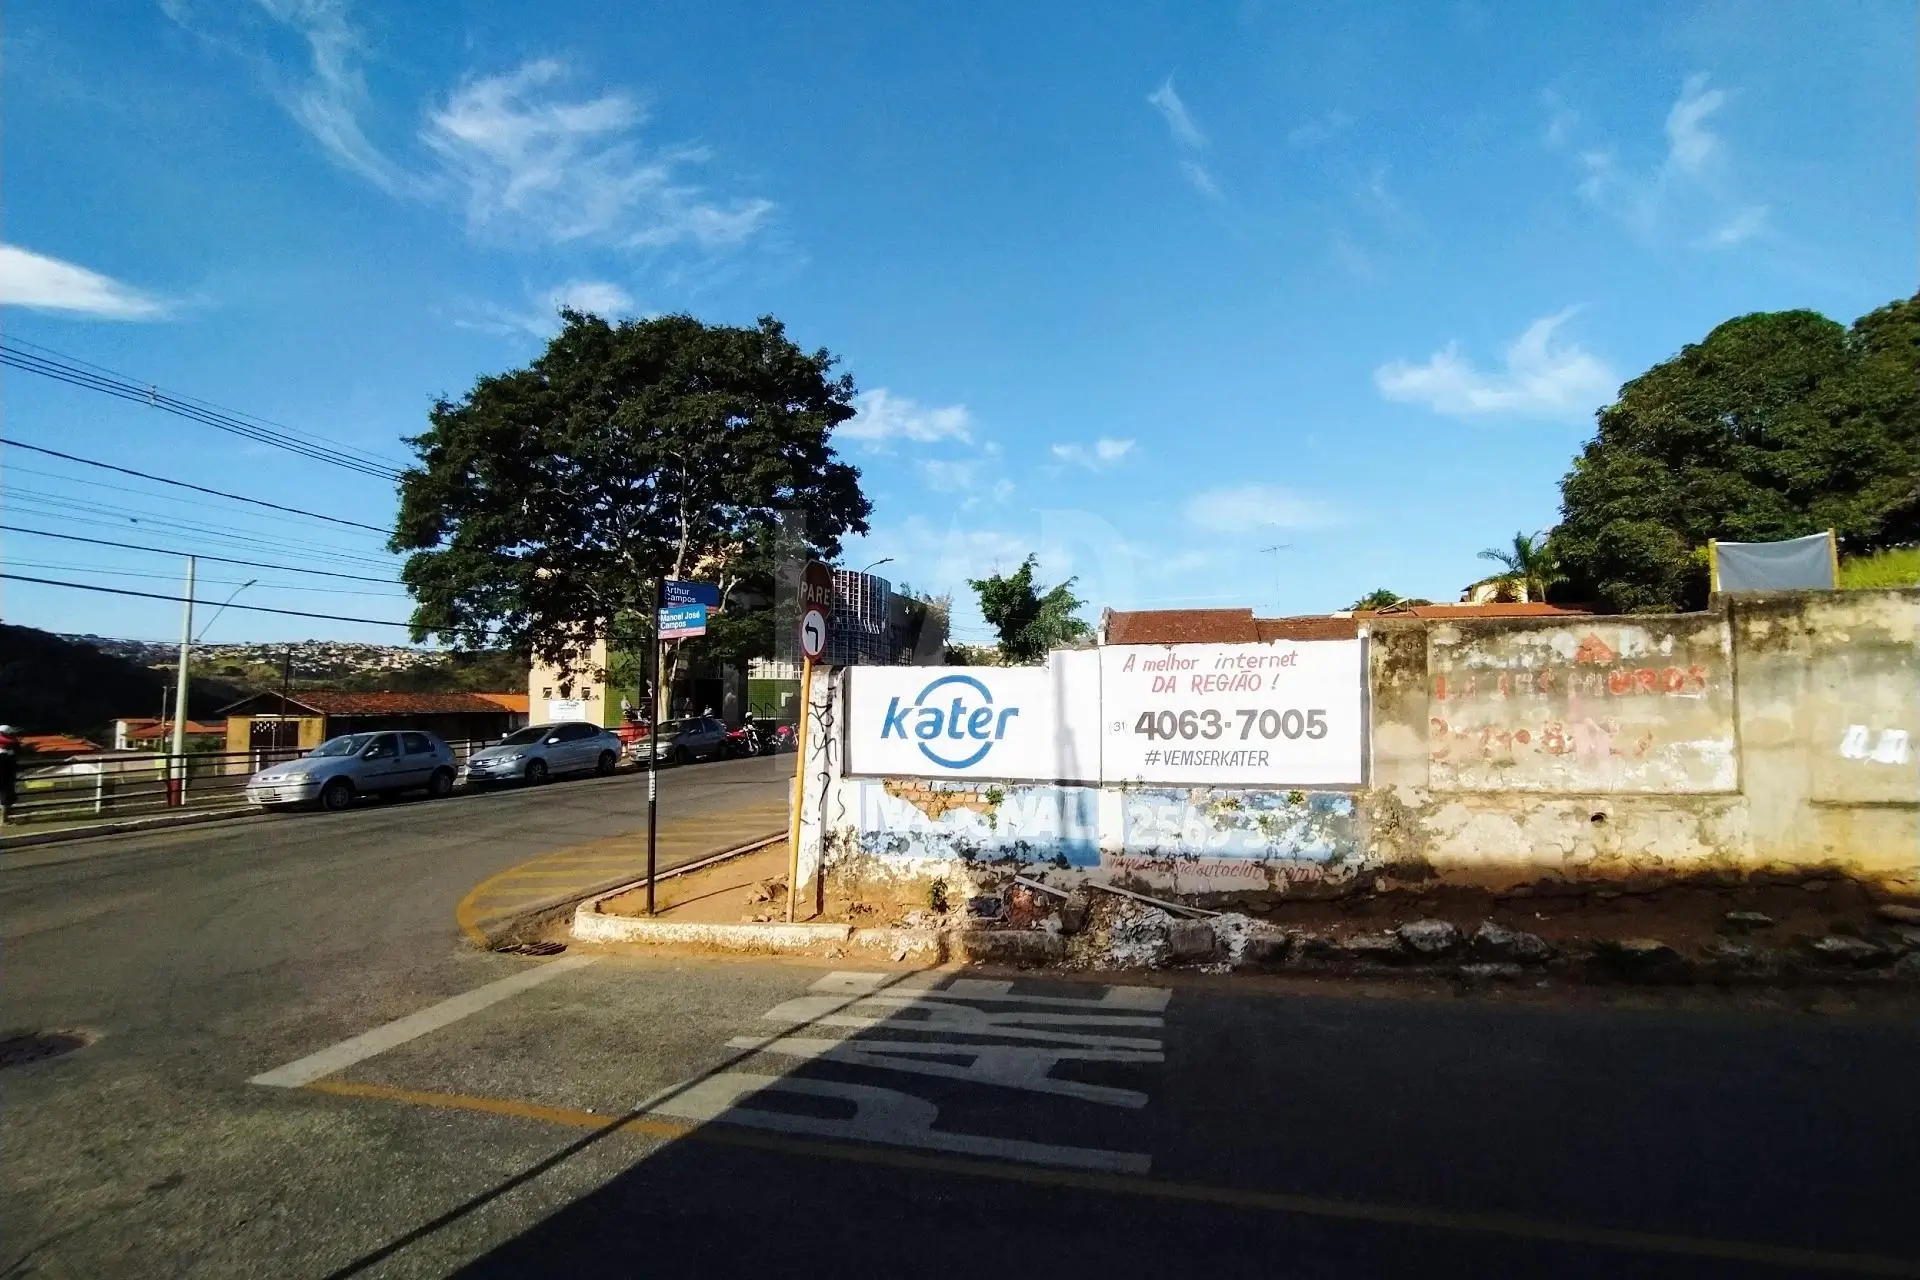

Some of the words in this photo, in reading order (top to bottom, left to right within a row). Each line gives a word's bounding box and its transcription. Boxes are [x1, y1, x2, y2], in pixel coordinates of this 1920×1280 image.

[665, 586, 690, 595] Arthur
[665, 593, 697, 603] Campos
[800, 581, 831, 605] PARE
[661, 613, 684, 622] Manoel
[684, 610, 701, 619] José
[661, 621, 687, 630] Campos
[1123, 653, 1137, 672] A
[1143, 653, 1200, 672] melhor
[1215, 650, 1299, 670] internet
[1151, 675, 1177, 693] DA
[1191, 670, 1262, 695] REGIÃO
[880, 696, 1020, 740] kater
[1144, 750, 1269, 767] #VEMSERKATER
